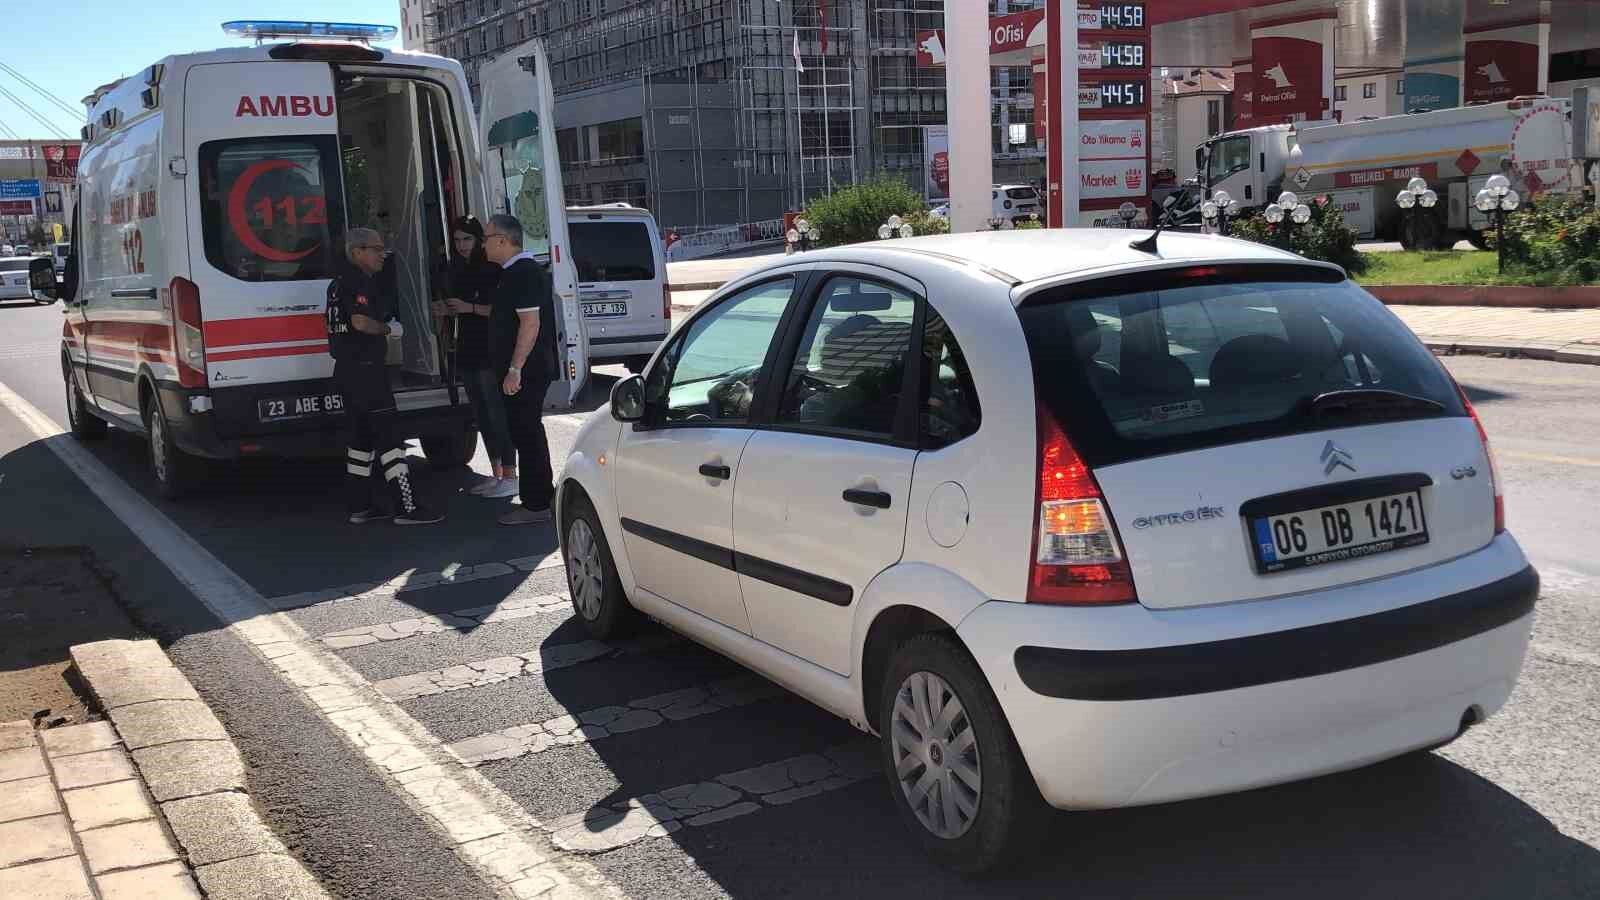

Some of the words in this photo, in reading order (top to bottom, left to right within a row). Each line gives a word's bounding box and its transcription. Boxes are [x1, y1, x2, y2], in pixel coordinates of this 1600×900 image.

[1101, 6, 1143, 27] 44.58
[994, 21, 1025, 45] Ofisi
[1102, 45, 1143, 66] 44.58
[1081, 134, 1097, 145] Oto
[1081, 174, 1117, 190] Market
[253, 195, 329, 229] 112
[583, 304, 593, 314] 23
[610, 303, 625, 313] 139
[268, 401, 286, 416] 23
[295, 397, 320, 414] ABE
[1273, 516, 1307, 556] 06
[1321, 507, 1352, 547] DB
[1364, 493, 1419, 539] 1421
